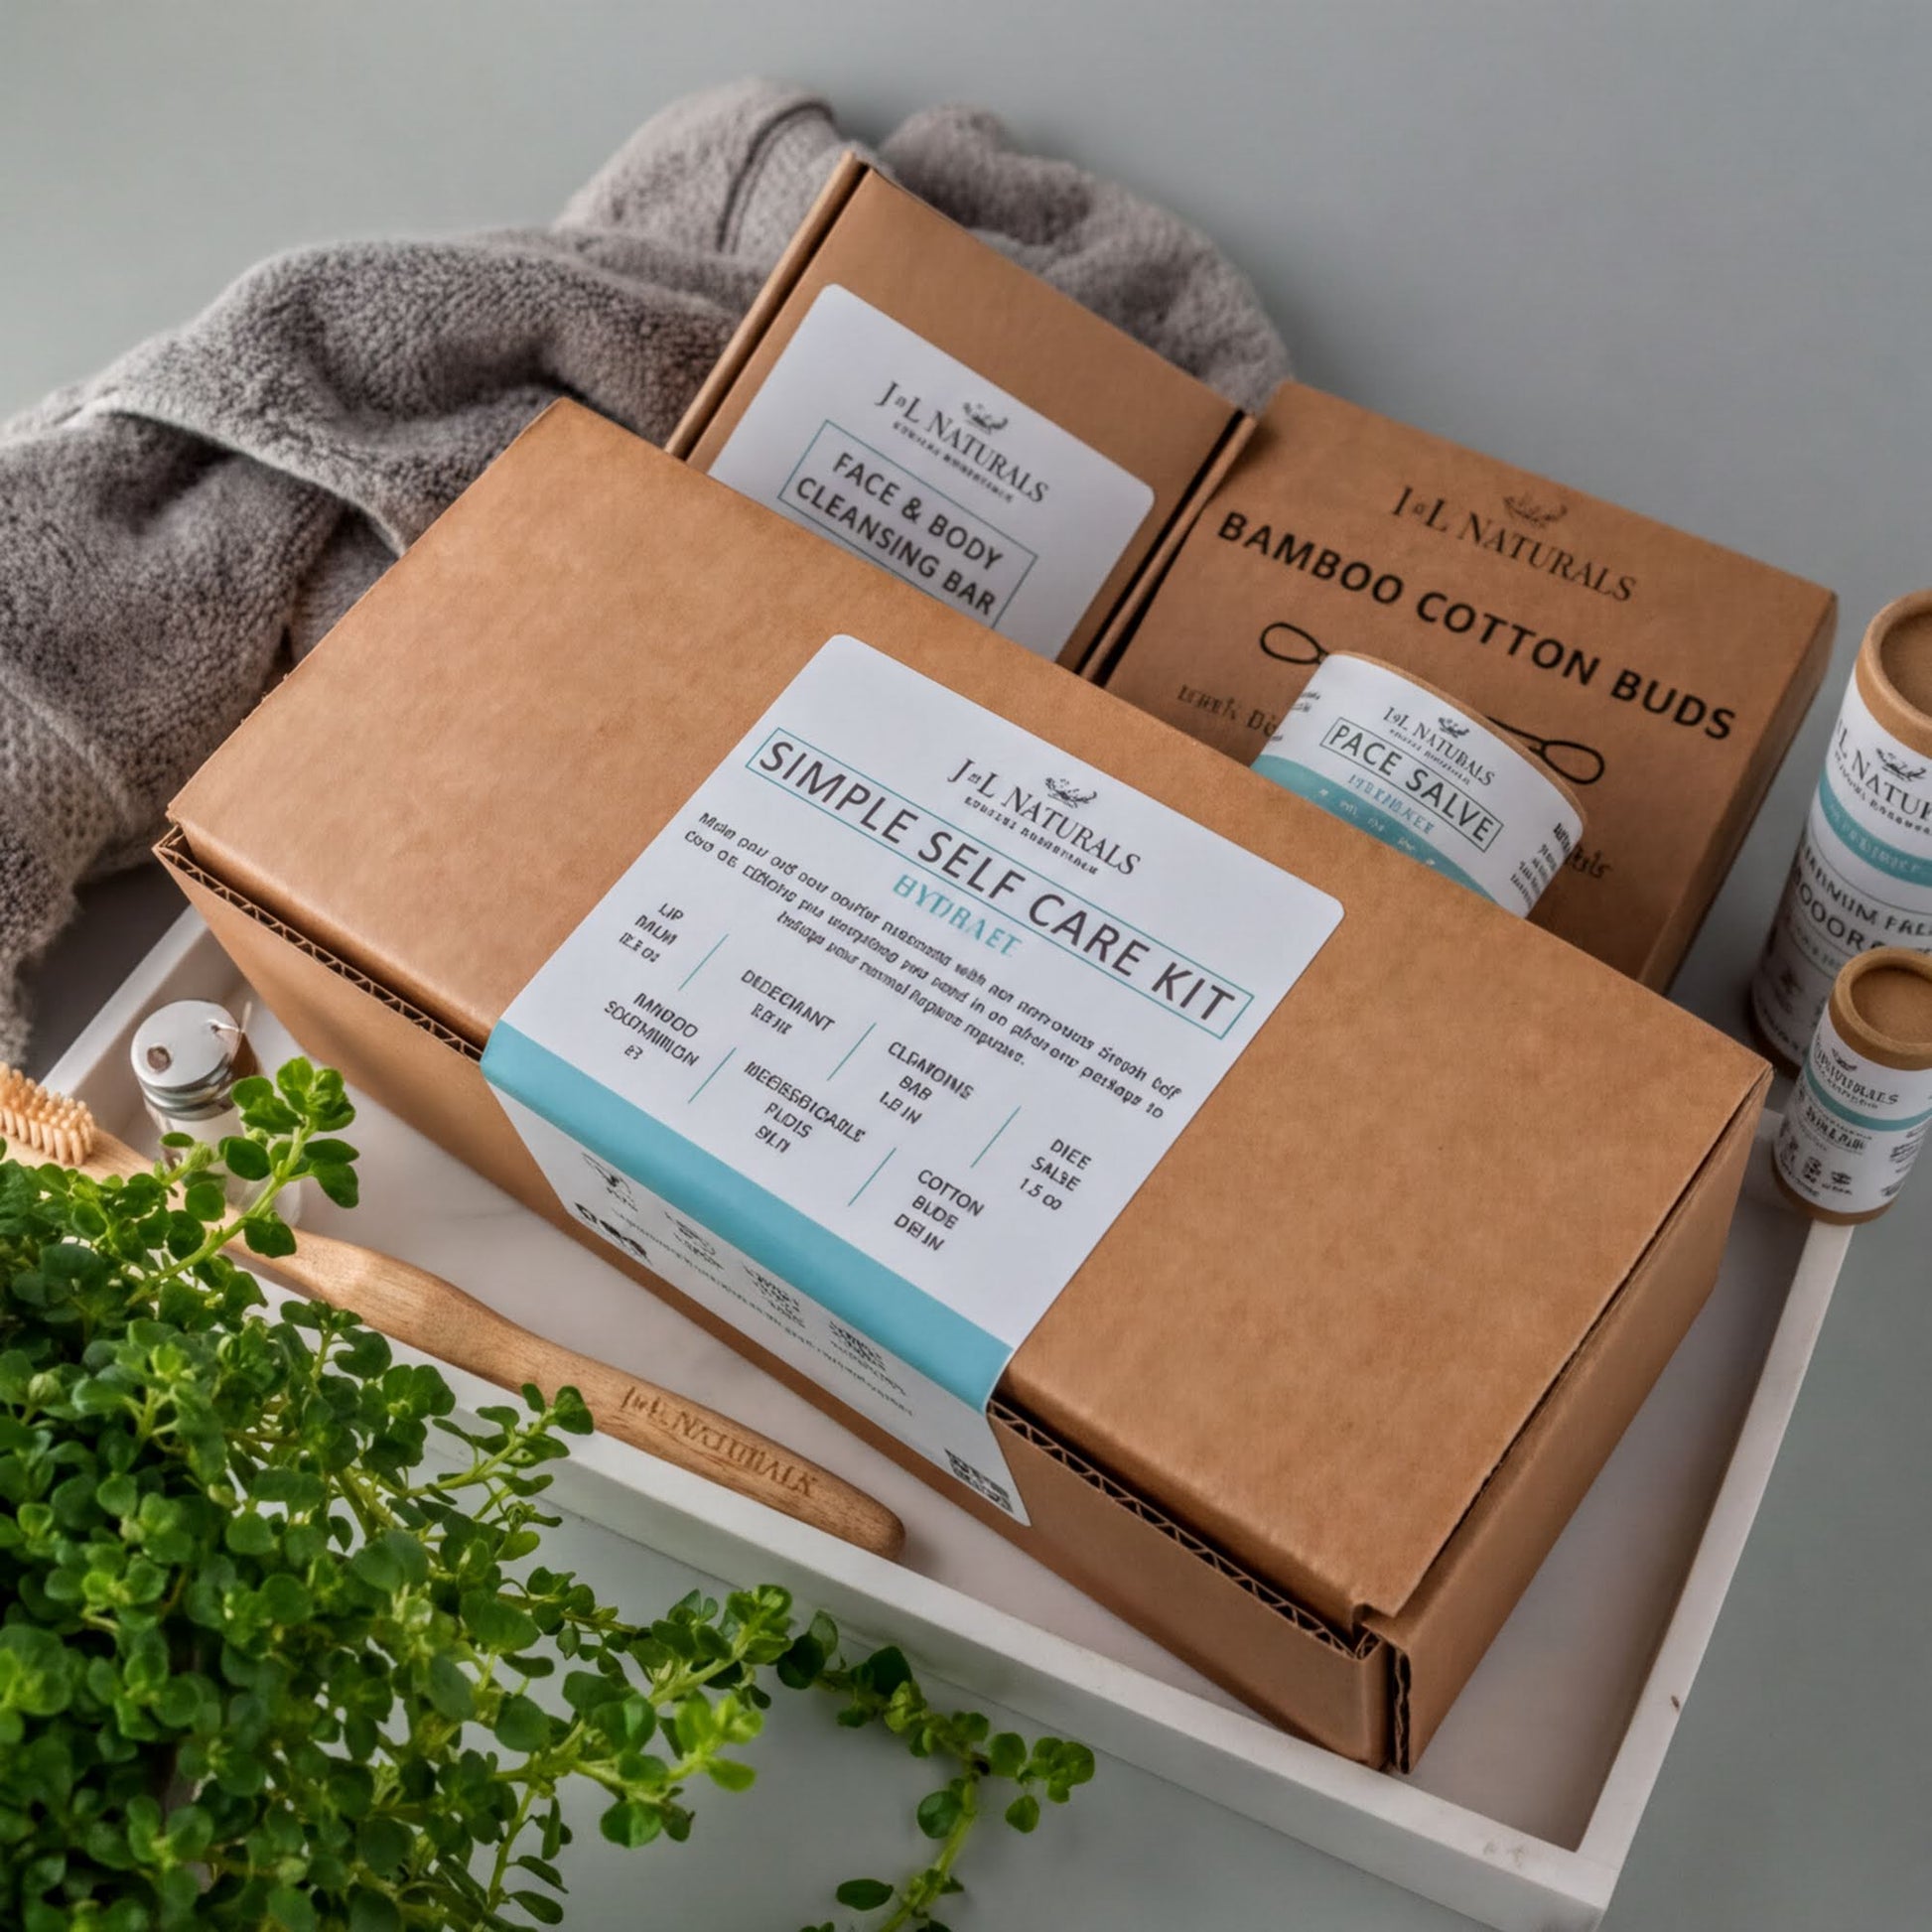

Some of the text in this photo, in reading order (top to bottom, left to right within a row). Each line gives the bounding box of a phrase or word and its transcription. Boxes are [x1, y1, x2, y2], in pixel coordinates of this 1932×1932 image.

[927, 410, 1048, 502] NATURALS
[797, 477, 997, 617] CLEANSING BAR
[833, 452, 900, 506] FACE
[901, 496, 922, 523] &
[928, 514, 1004, 571] BODY
[1456, 511, 1637, 602] NATURALS
[1217, 511, 1736, 741] BAMBOO COTTON BUDS
[1001, 785, 1142, 876] NATURALS
[1405, 765, 1495, 844] SALVE
[759, 740, 919, 845] SIMPLE
[917, 830, 1026, 899] SELF
[1029, 894, 1151, 976] CARE
[1152, 961, 1236, 1022] KIT
[917, 1169, 986, 1217] COTTON
